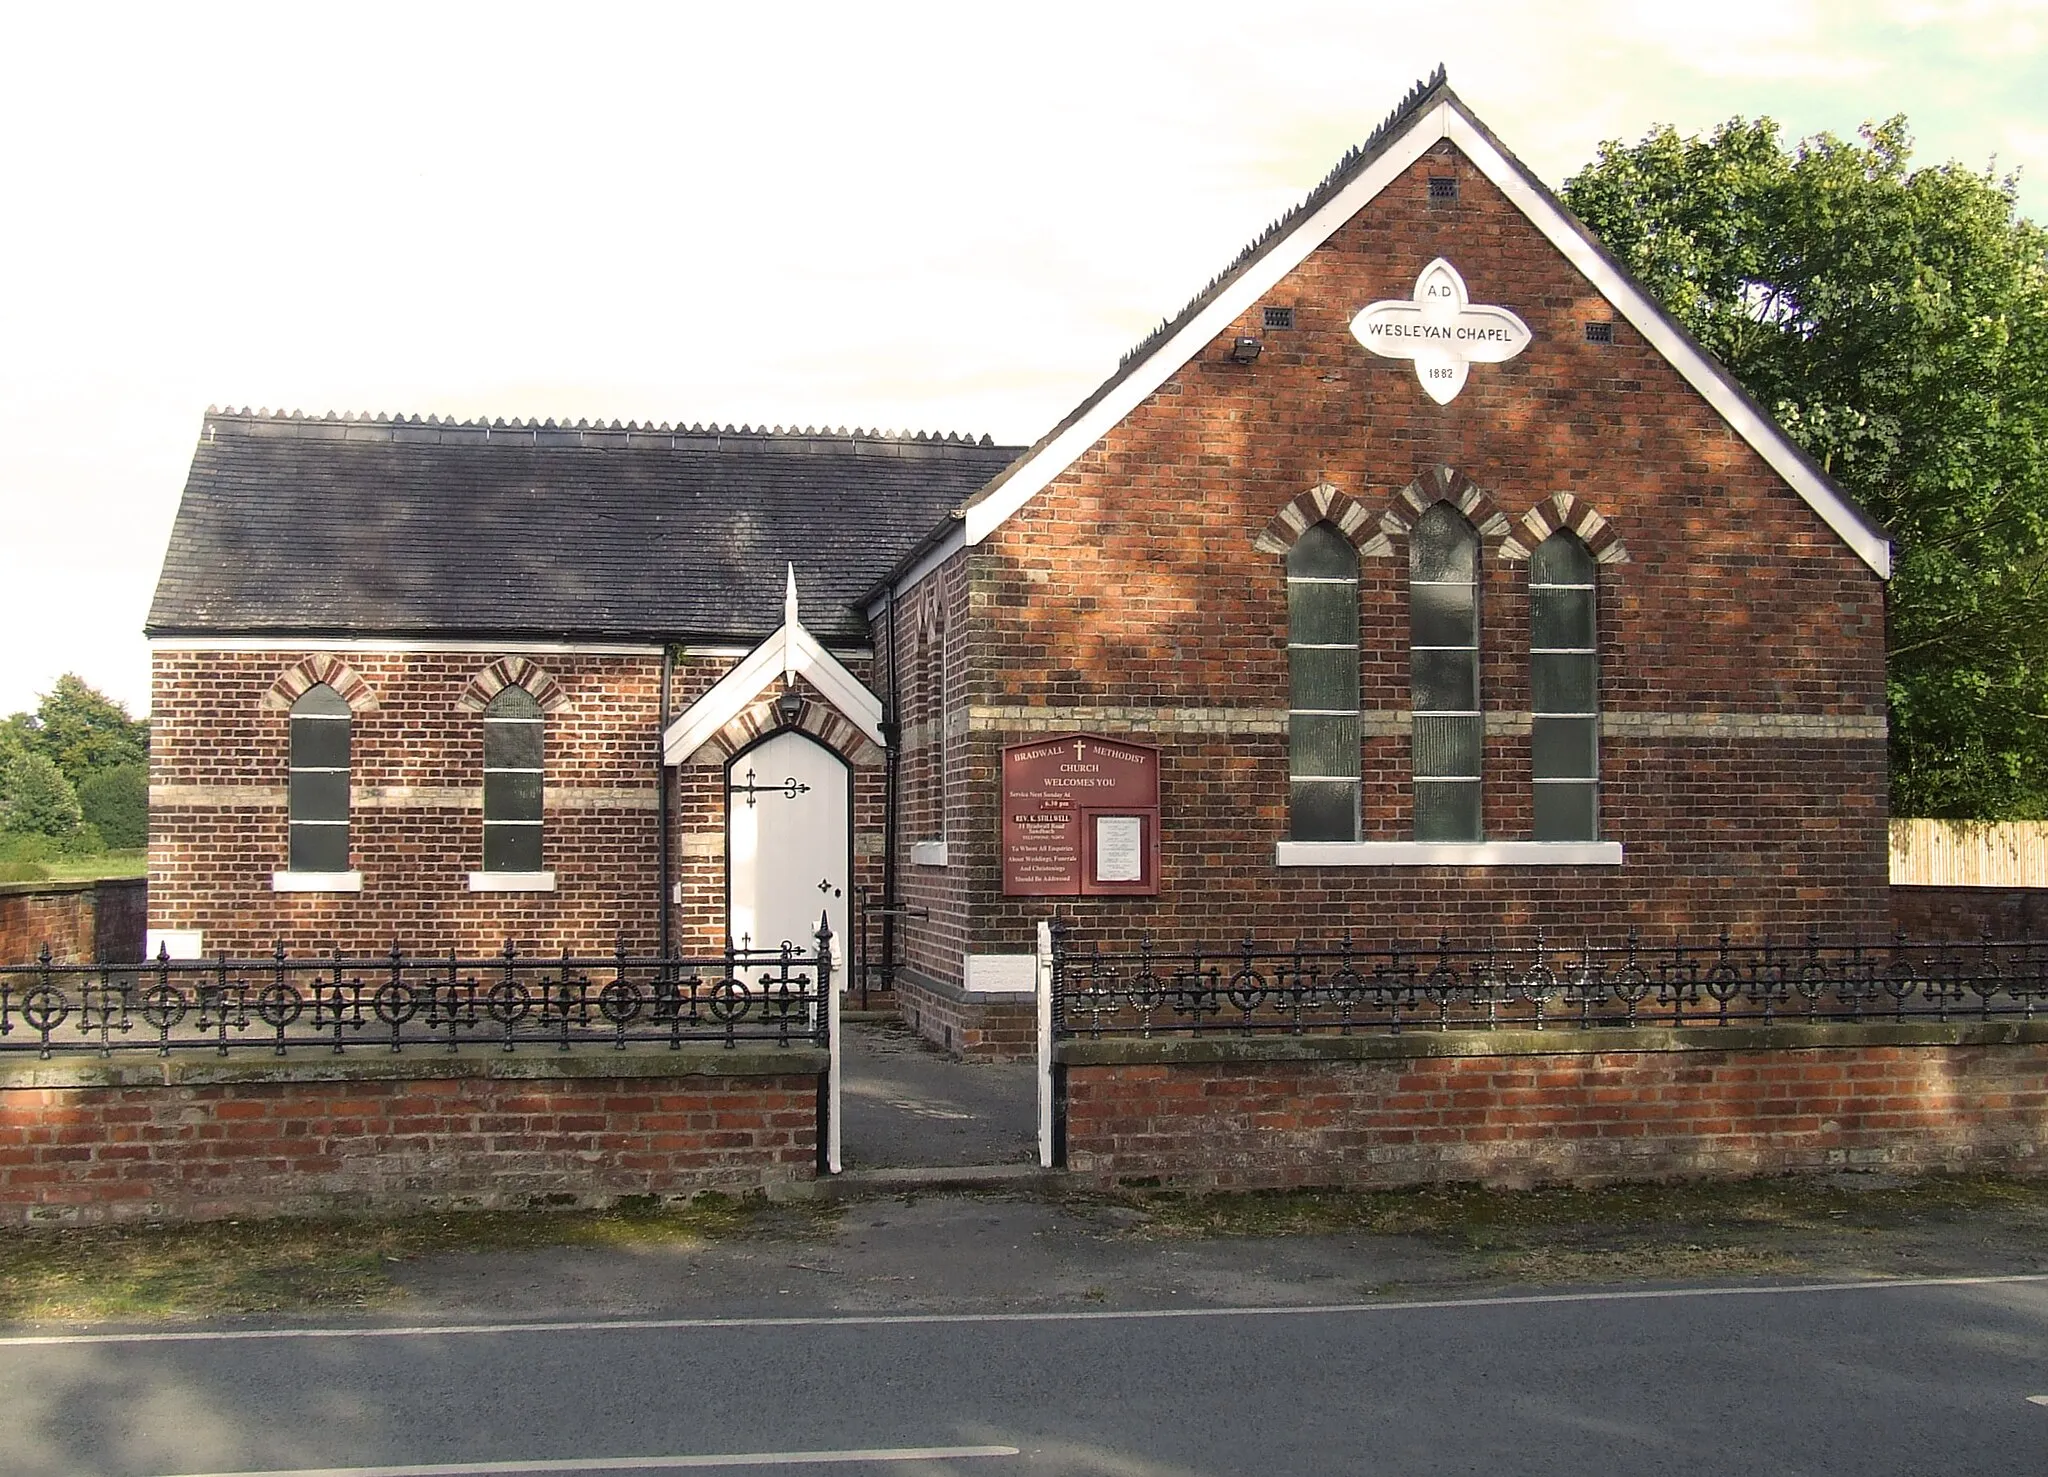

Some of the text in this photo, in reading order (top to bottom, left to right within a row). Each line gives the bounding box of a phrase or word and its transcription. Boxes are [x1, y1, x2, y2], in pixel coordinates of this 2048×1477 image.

[1369, 323, 1512, 342] WESLEYAN CHAPEL
[1429, 368, 1453, 379] 1882
[1014, 745, 1145, 764] BRADWALL METHODIST
[1060, 763, 1099, 772] CHURCH
[1044, 778, 1116, 787] WELCOMES YOU
[1043, 791, 1063, 799] Sunday
